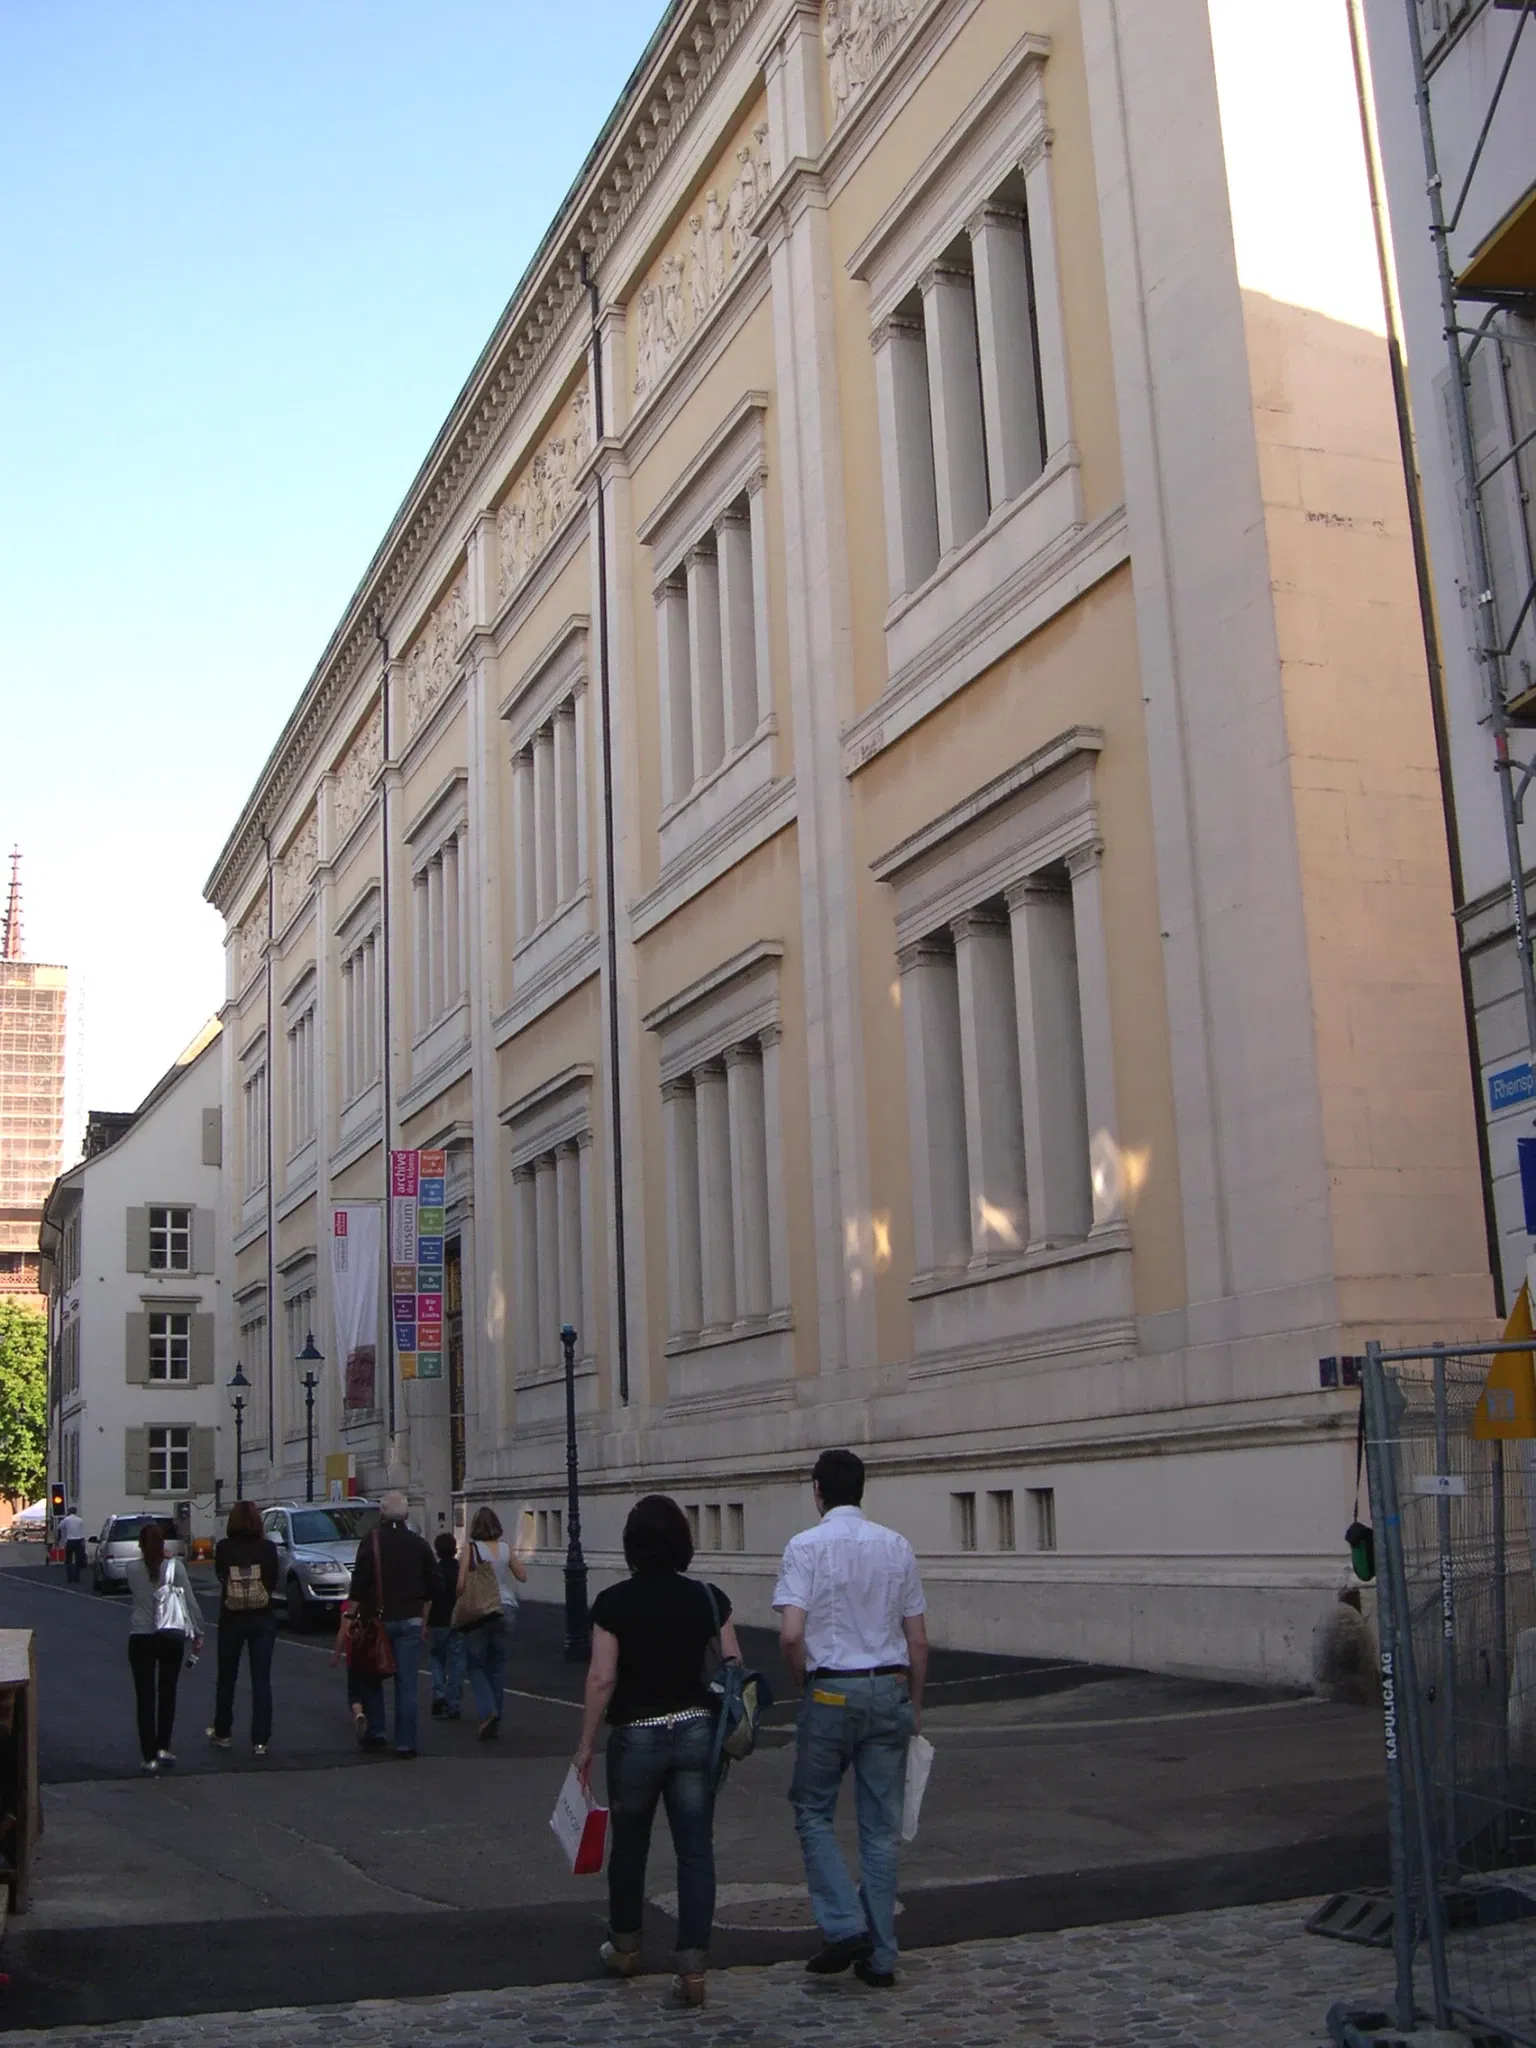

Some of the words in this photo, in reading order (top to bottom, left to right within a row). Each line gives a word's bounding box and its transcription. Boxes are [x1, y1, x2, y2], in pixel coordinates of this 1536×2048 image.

[395, 1152, 406, 1194] archive
[407, 1180, 415, 1194] des
[404, 1203, 413, 1261] museum
[1381, 1652, 1393, 1674] AG
[1383, 1678, 1398, 1760] KAPULICA
